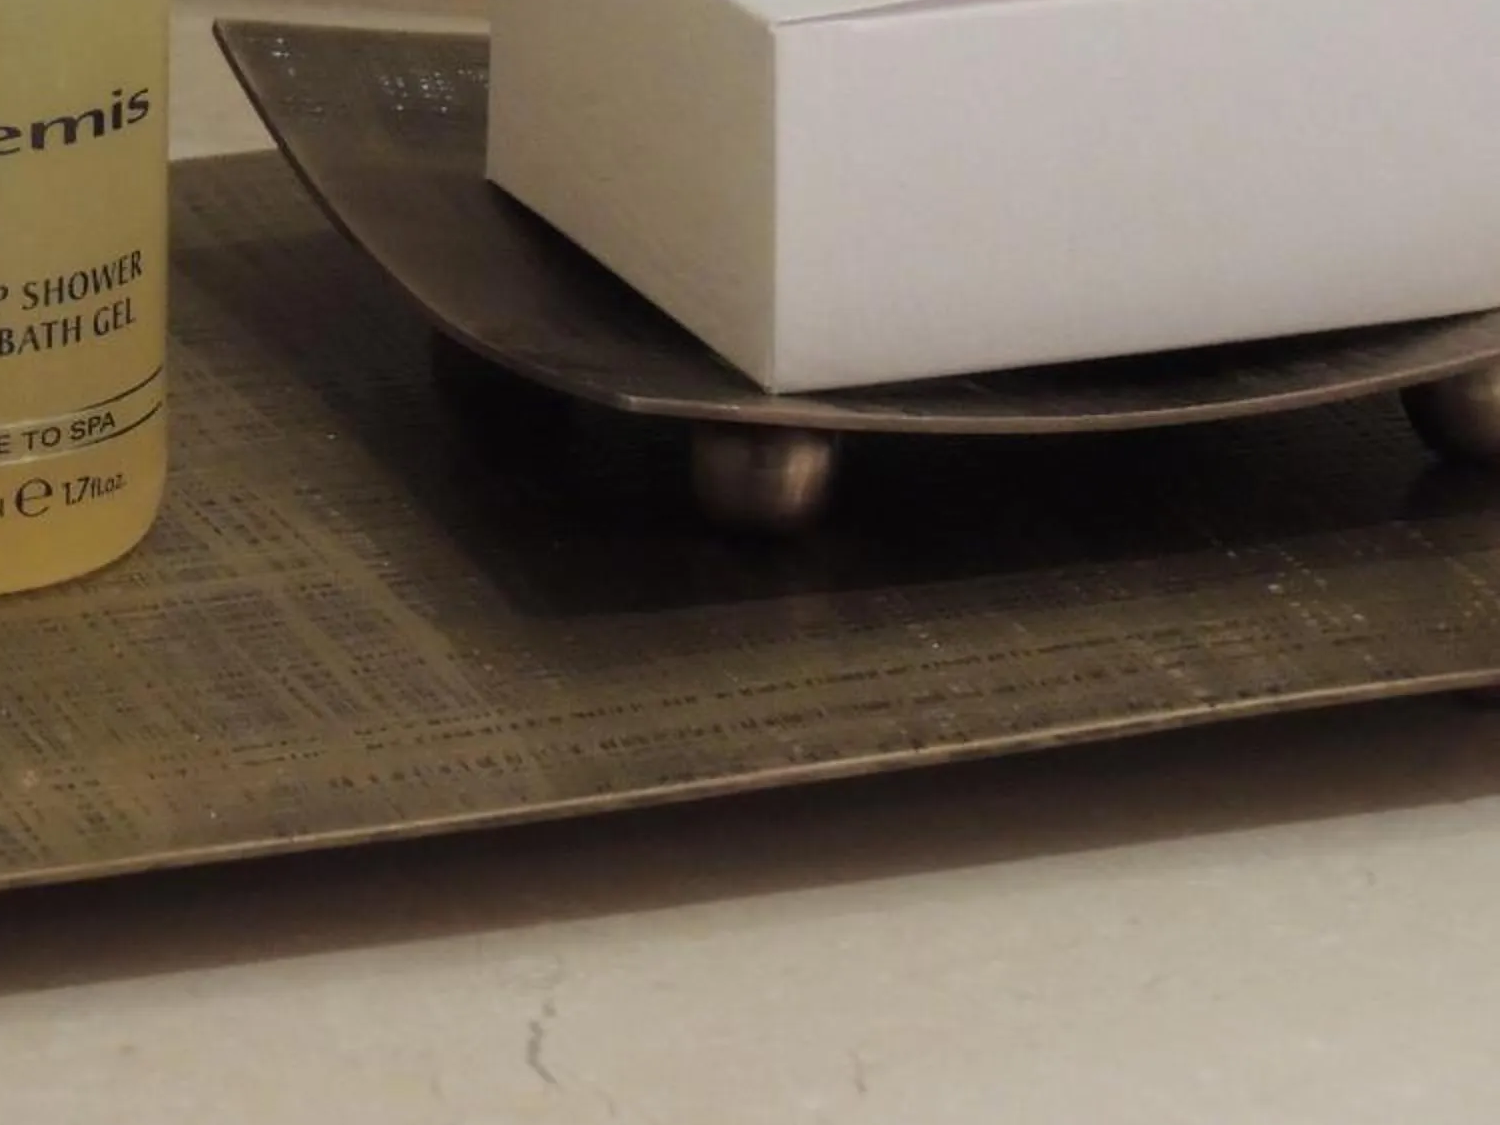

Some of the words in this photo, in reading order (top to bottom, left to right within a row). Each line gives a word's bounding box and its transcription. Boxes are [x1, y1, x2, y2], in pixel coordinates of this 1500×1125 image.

[21, 250, 143, 311] SHOWER
[93, 297, 137, 337] GEL
[22, 426, 61, 451] TO
[70, 410, 116, 442] SPA
